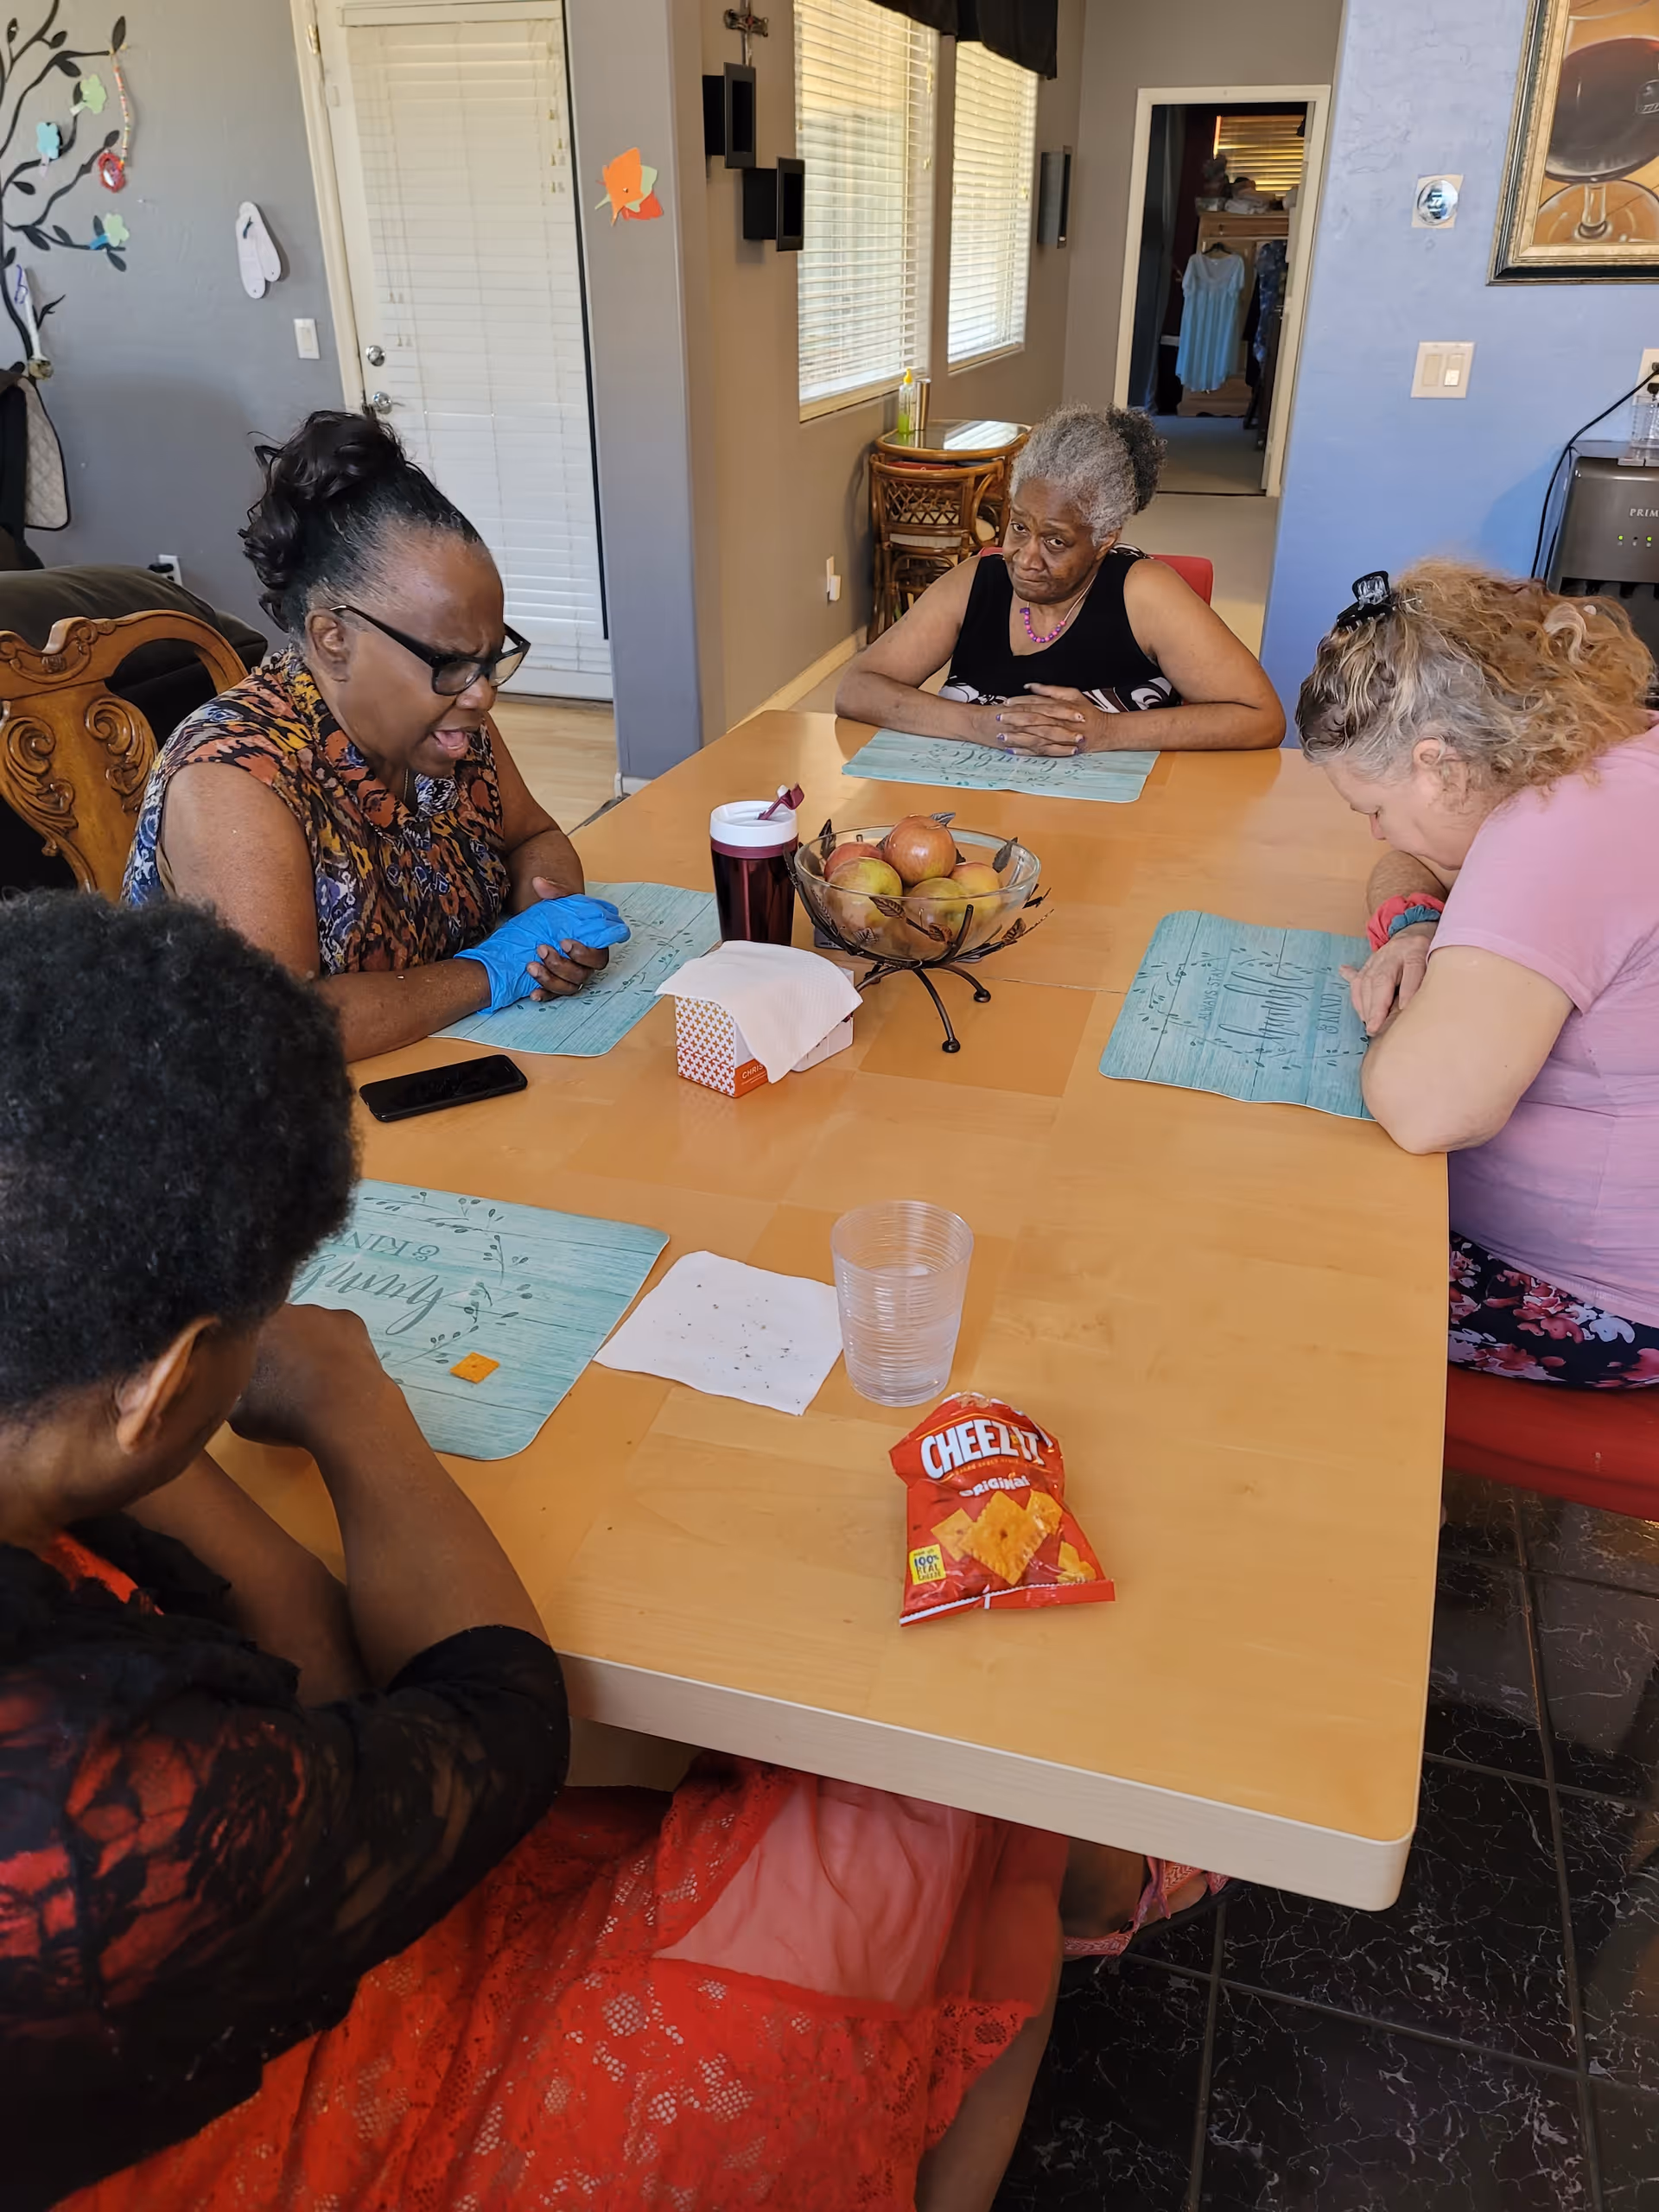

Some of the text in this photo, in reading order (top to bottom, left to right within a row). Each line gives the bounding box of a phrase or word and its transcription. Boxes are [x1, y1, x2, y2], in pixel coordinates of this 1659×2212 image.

[1198, 967, 1224, 1020] ALWAYS STAY
[1316, 994, 1342, 1034] & KIND
[333, 1230, 440, 1262] & KIN
